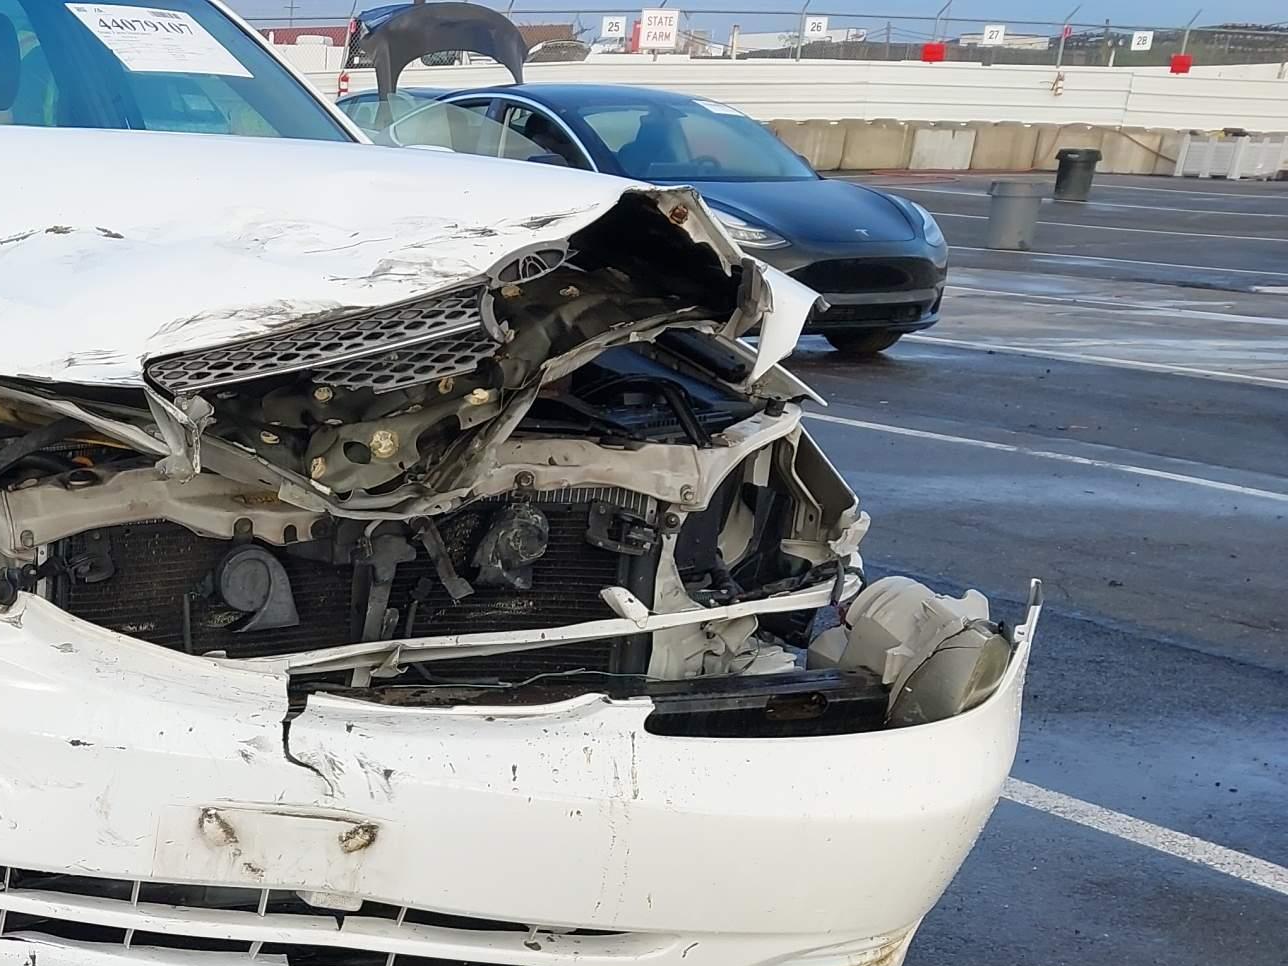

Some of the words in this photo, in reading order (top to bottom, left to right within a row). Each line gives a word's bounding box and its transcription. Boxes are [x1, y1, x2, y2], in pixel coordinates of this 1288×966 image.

[648, 16, 674, 26] STATE
[98, 18, 194, 35] 44079107
[608, 22, 620, 32] 25
[810, 22, 822, 32] 26
[646, 31, 671, 41] FARM
[988, 30, 1000, 39] 27
[1136, 35, 1148, 45] 28
